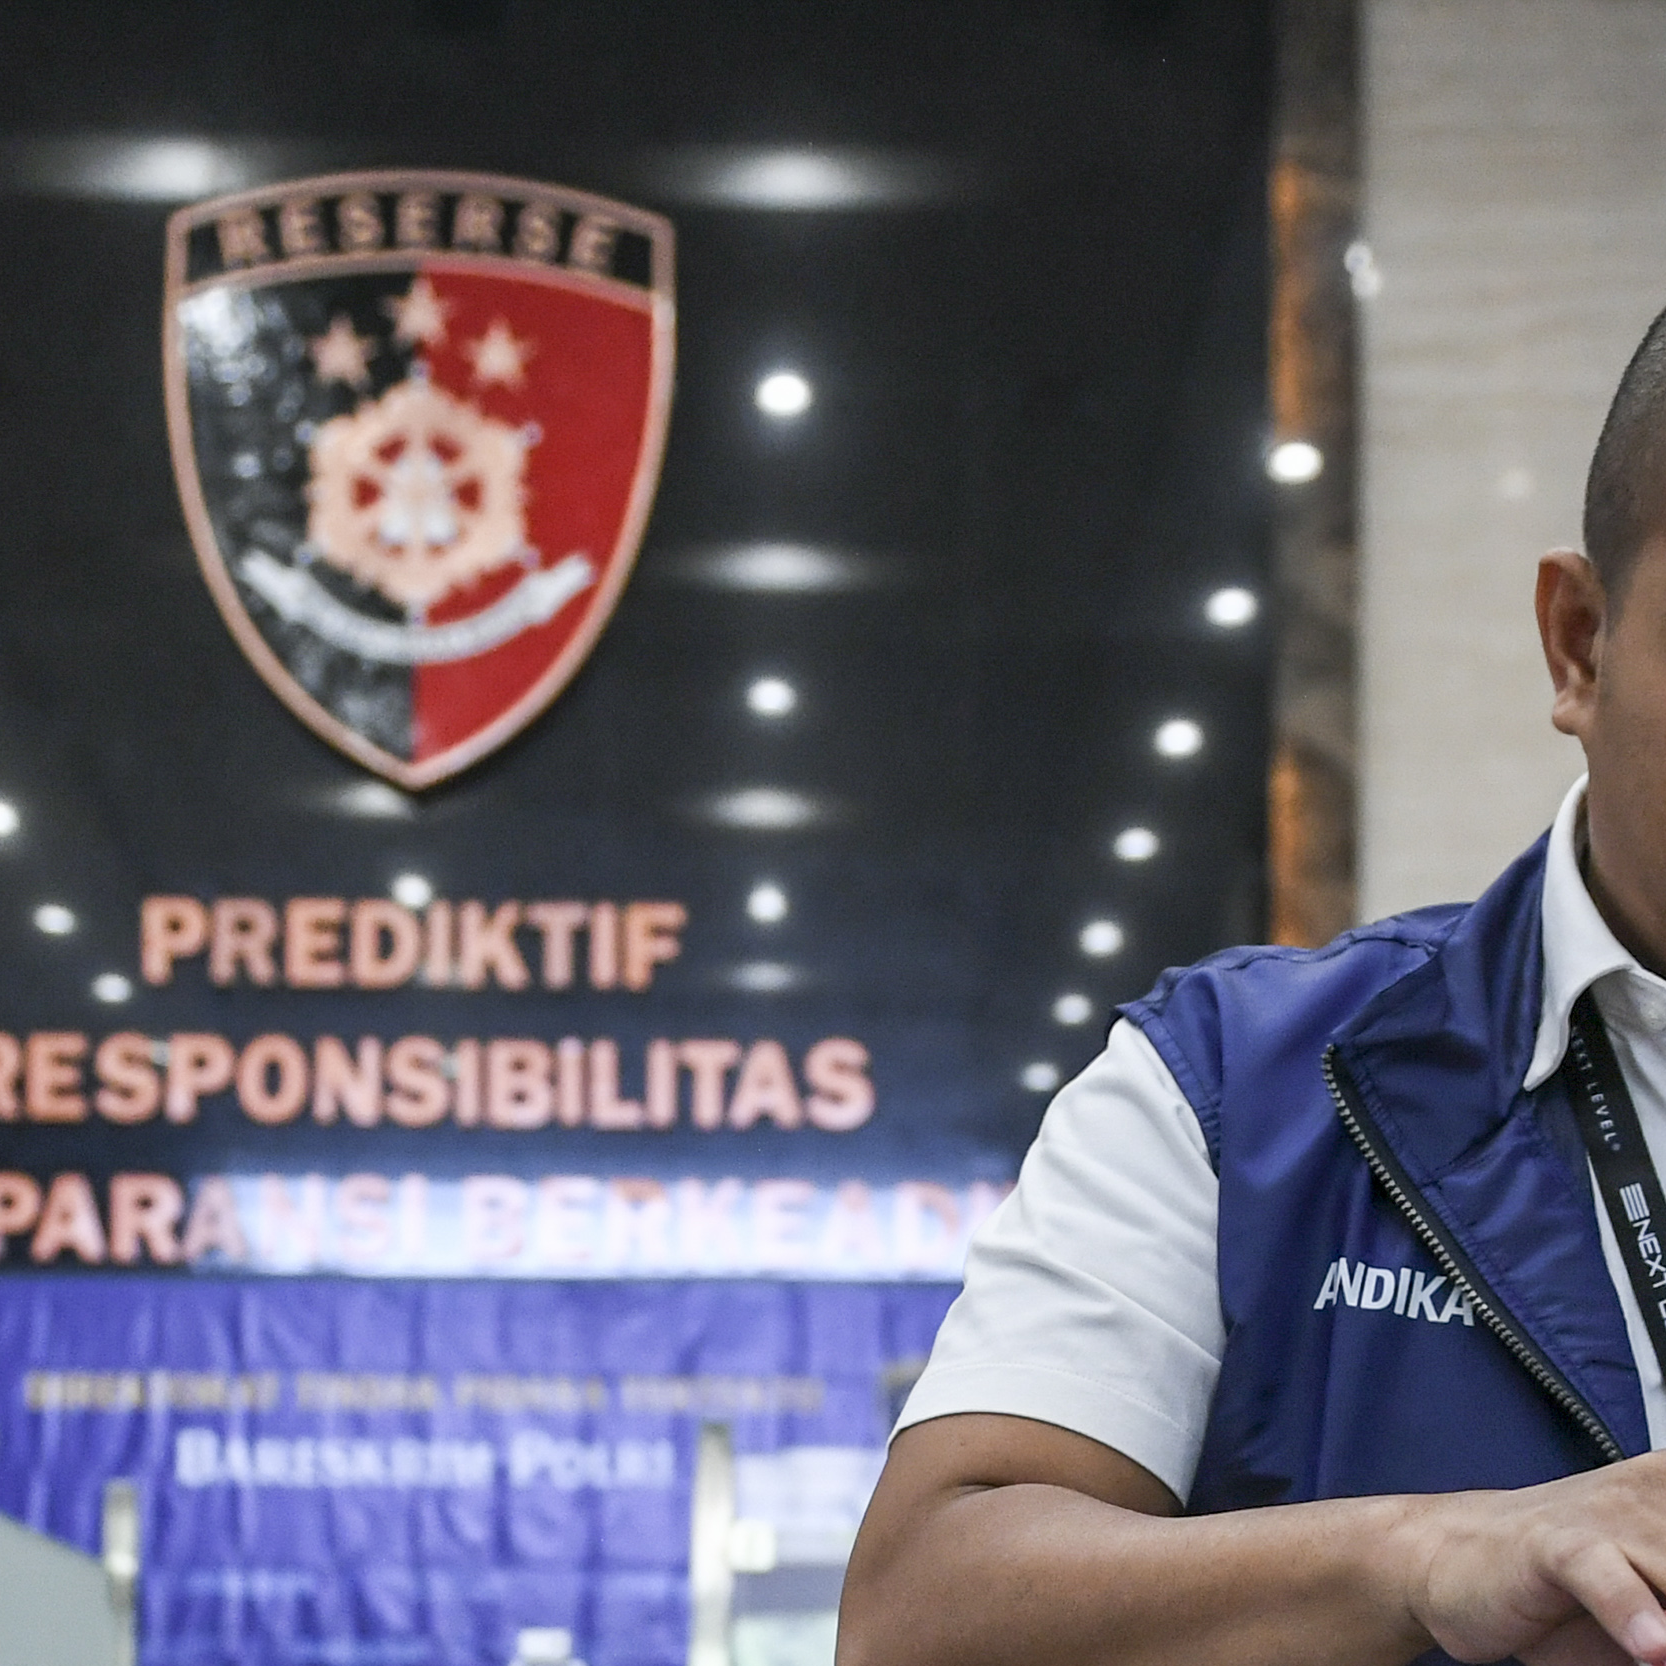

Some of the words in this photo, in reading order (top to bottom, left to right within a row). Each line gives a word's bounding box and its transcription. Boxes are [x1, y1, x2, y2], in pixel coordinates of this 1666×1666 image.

[217, 192, 617, 272] RESERSE
[140, 896, 688, 992] PREDIKTIF
[1312, 1256, 1475, 1328] ANDIKA
